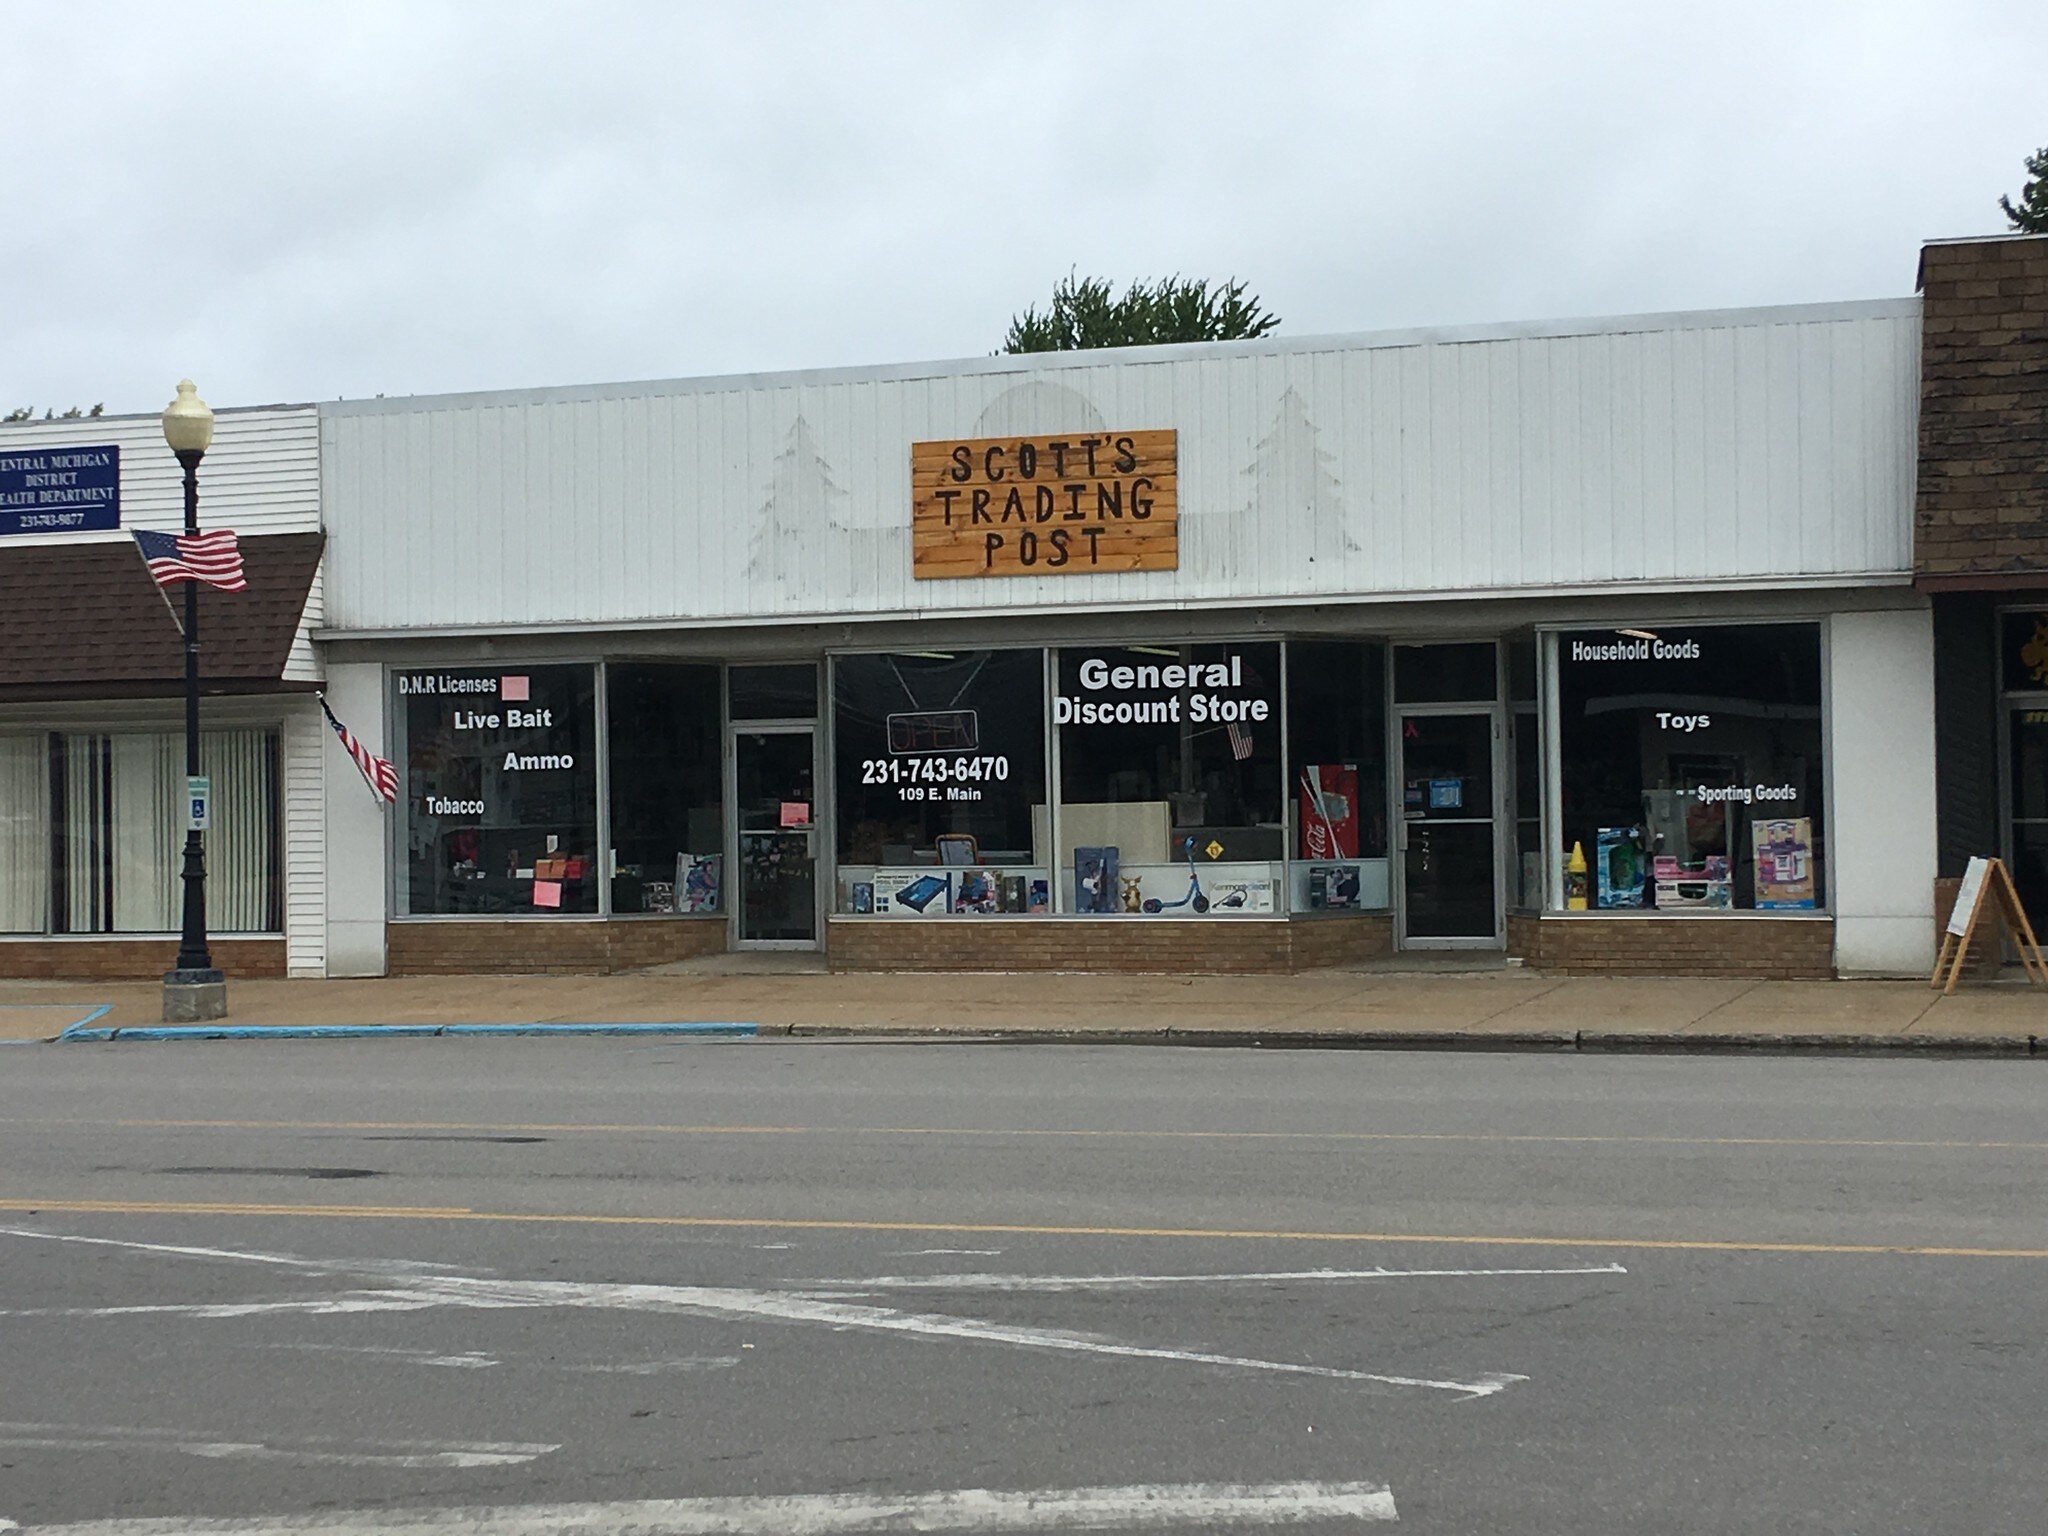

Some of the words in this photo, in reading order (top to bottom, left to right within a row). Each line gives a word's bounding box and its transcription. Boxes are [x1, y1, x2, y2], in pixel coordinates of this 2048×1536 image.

[0, 457, 47, 471] ENTRAL
[51, 453, 110, 468] MICHIGAN
[951, 435, 1137, 482] SCOTT'S
[25, 472, 77, 487] DISTRICT
[0, 490, 35, 505] EALTH
[40, 487, 113, 503] DEPARTMENT
[935, 479, 1154, 526] TRADING
[985, 527, 1106, 567] POST
[1572, 640, 1649, 661] Household
[1653, 639, 1700, 659] Goods
[1080, 655, 1241, 690] General
[400, 676, 435, 694] D.N.R
[439, 675, 497, 692] Licenses
[454, 711, 500, 729] Live
[507, 709, 552, 727] Bait
[1054, 695, 1180, 724] Discount
[1189, 694, 1269, 722] Store
[892, 714, 975, 750] OPEN
[1656, 712, 1710, 732] Toys
[503, 752, 574, 770] Ammo
[862, 756, 1008, 784] 231-743-6470
[898, 788, 924, 800] 109
[928, 788, 942, 800] E.
[947, 787, 981, 800] Main
[1697, 785, 1751, 804] Sporting
[1755, 784, 1797, 801] Goods
[426, 797, 484, 814] Tobacco
